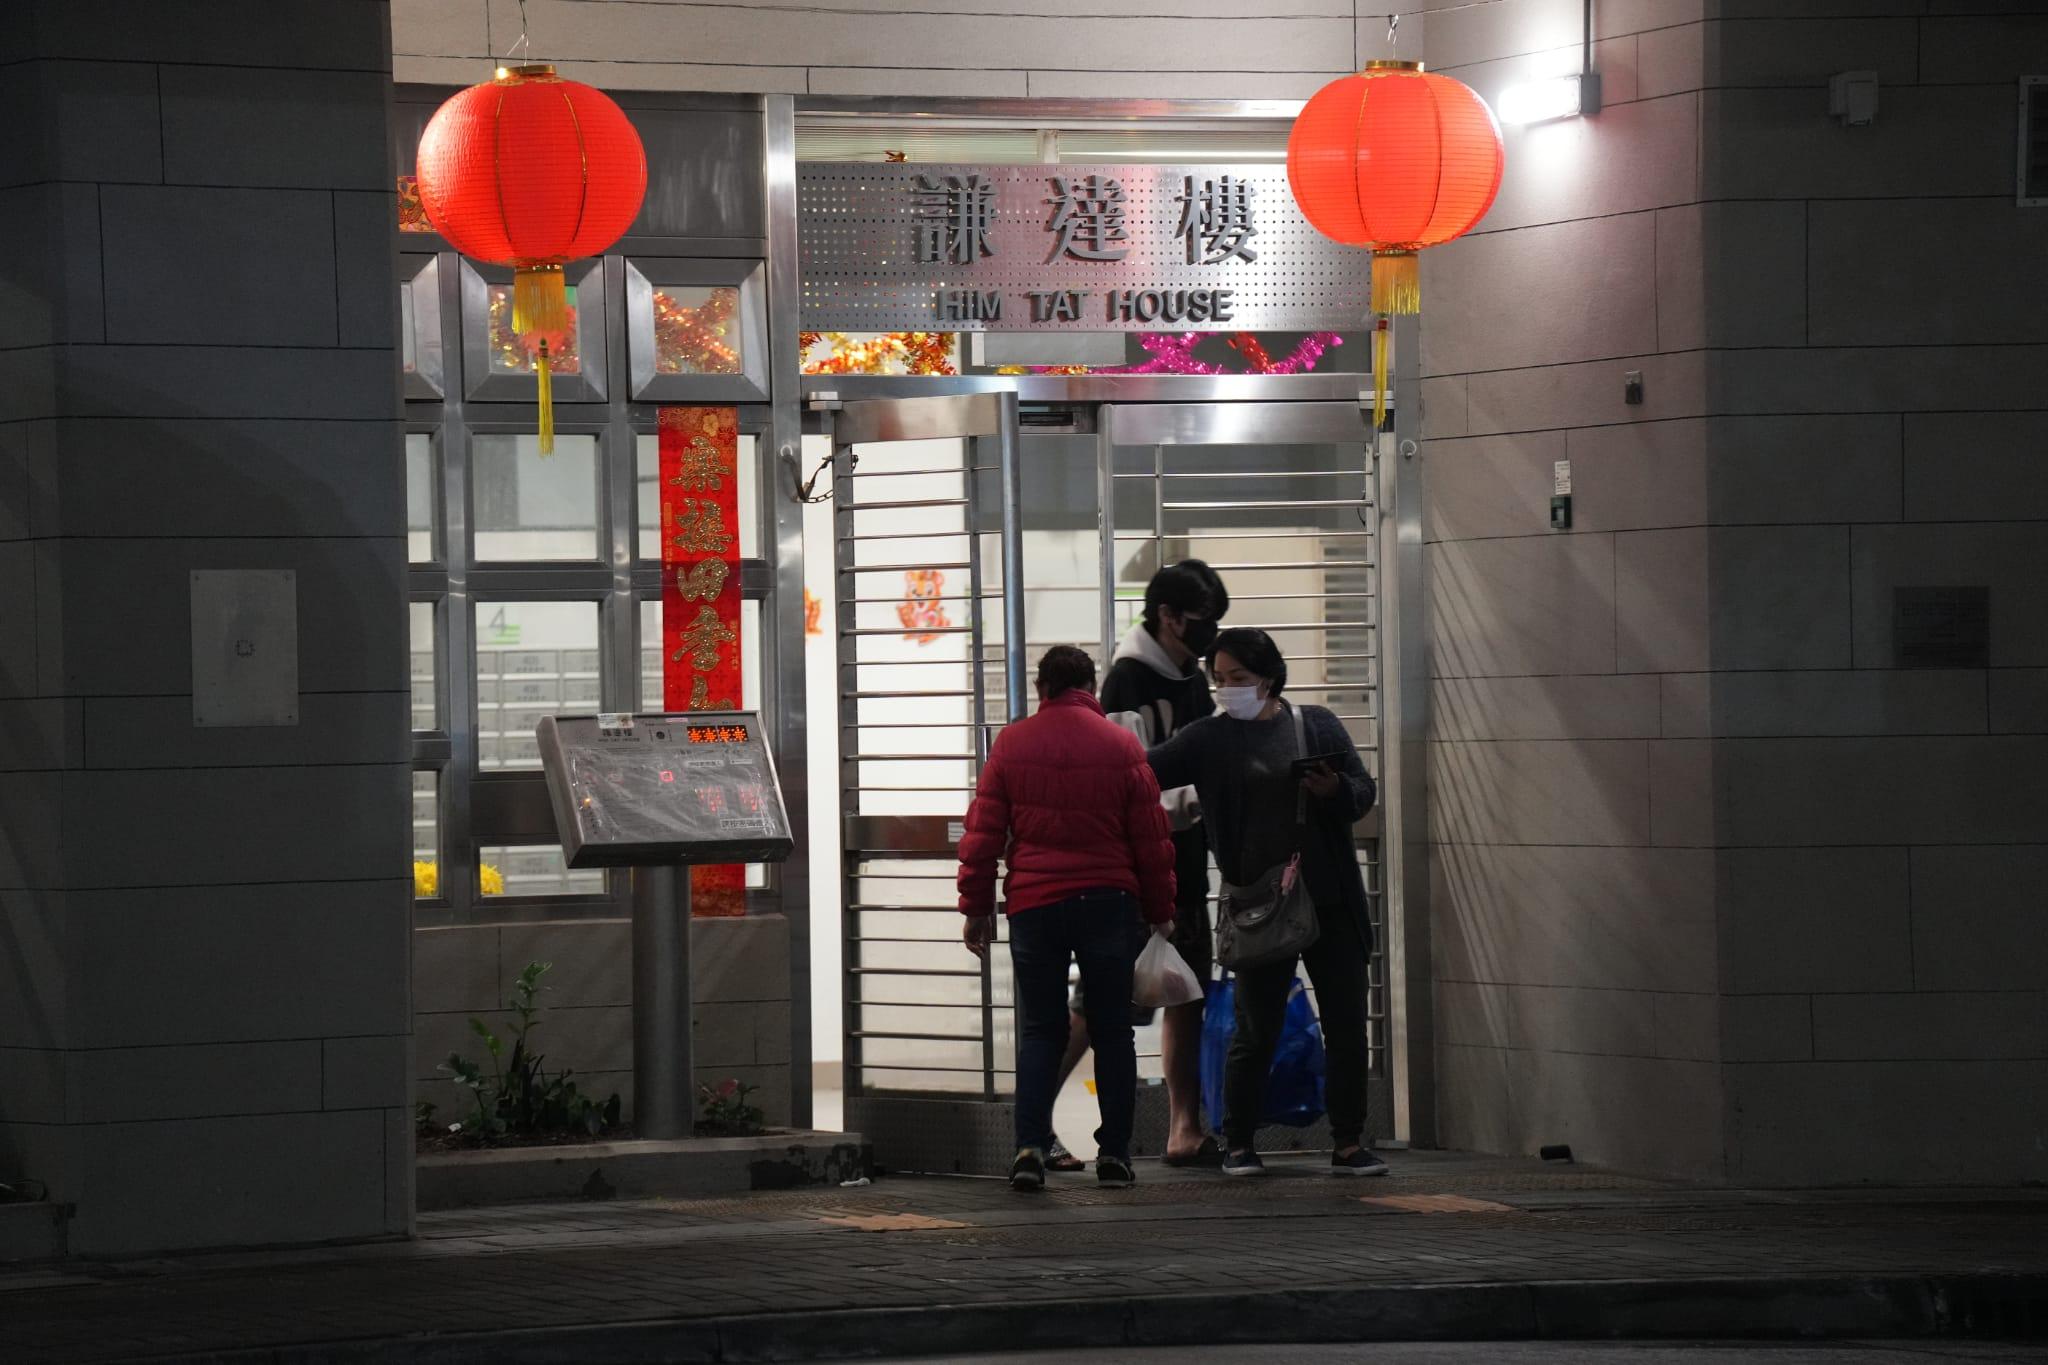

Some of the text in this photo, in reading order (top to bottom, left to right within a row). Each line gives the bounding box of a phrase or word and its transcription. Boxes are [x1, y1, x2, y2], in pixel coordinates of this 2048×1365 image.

[911, 173, 1258, 265] 謙達樓
[938, 290, 1235, 322] HIM TAT HOUSE
[488, 606, 507, 636] 4
